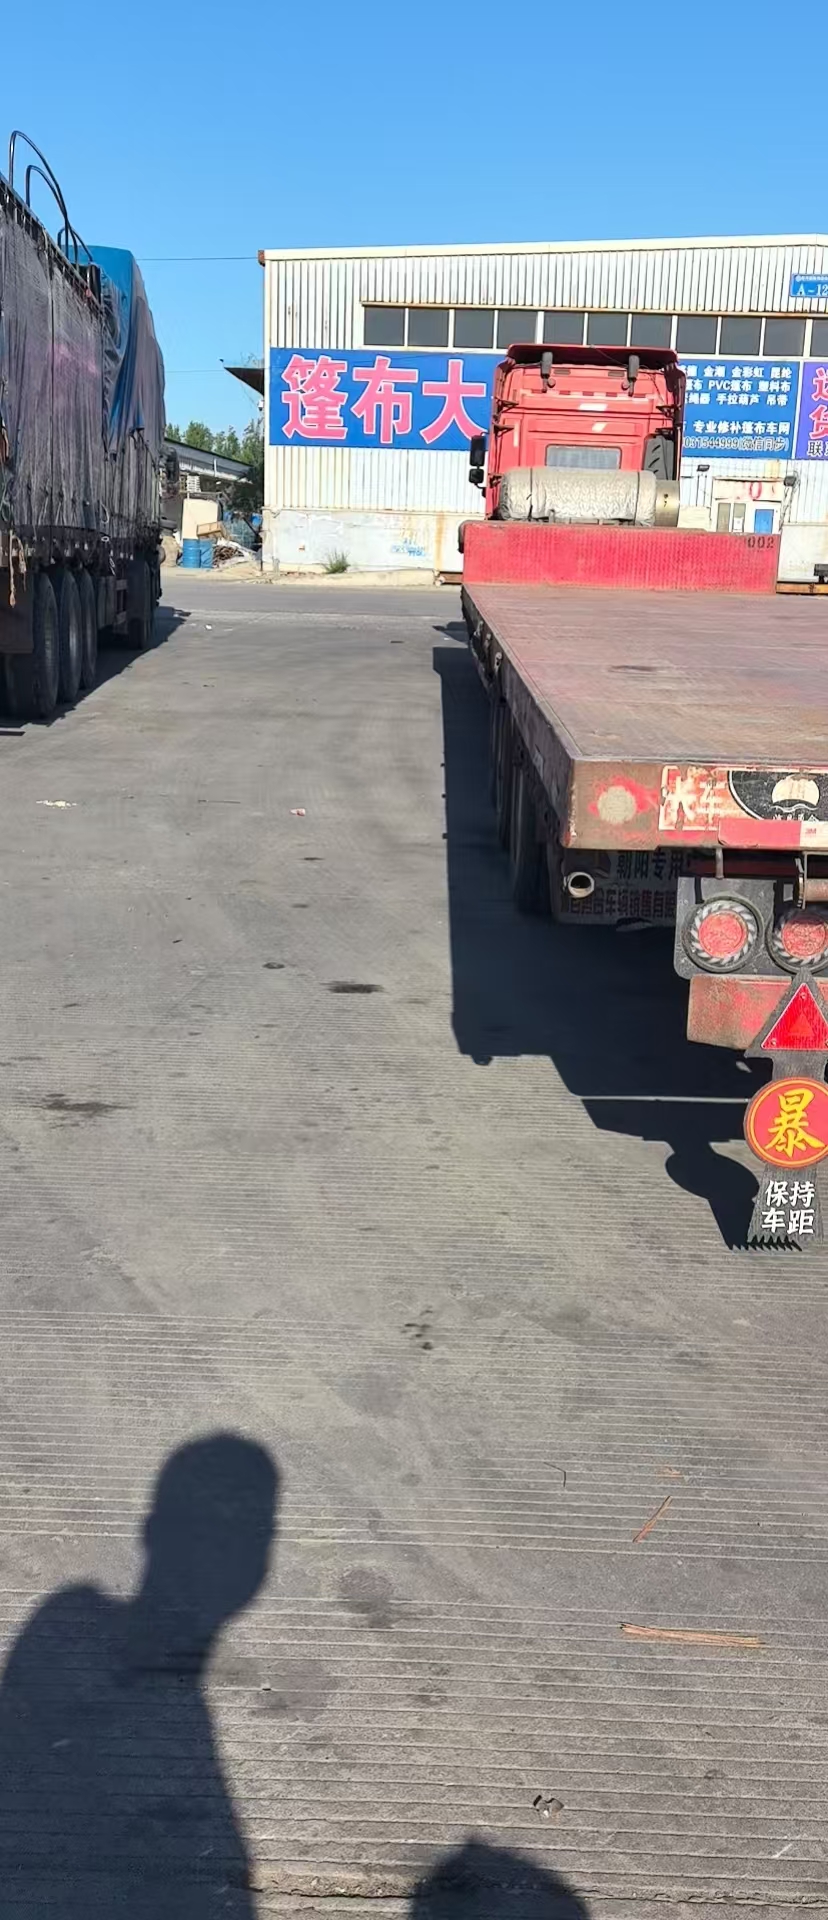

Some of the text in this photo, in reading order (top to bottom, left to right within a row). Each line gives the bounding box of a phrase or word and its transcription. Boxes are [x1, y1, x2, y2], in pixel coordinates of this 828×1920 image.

[708, 380, 753, 392] PVC篷布
[758, 381, 791, 393] 塑料布
[281, 354, 488, 444] 篷布大
[684, 393, 788, 406] 绳器 手拉葫芦 吊带
[693, 420, 791, 435] 专业修补篷布车网
[807, 441, 828, 457] 联
[764, 1088, 826, 1159] 暴
[765, 1180, 815, 1207] 保持
[761, 1207, 815, 1235] 车距
